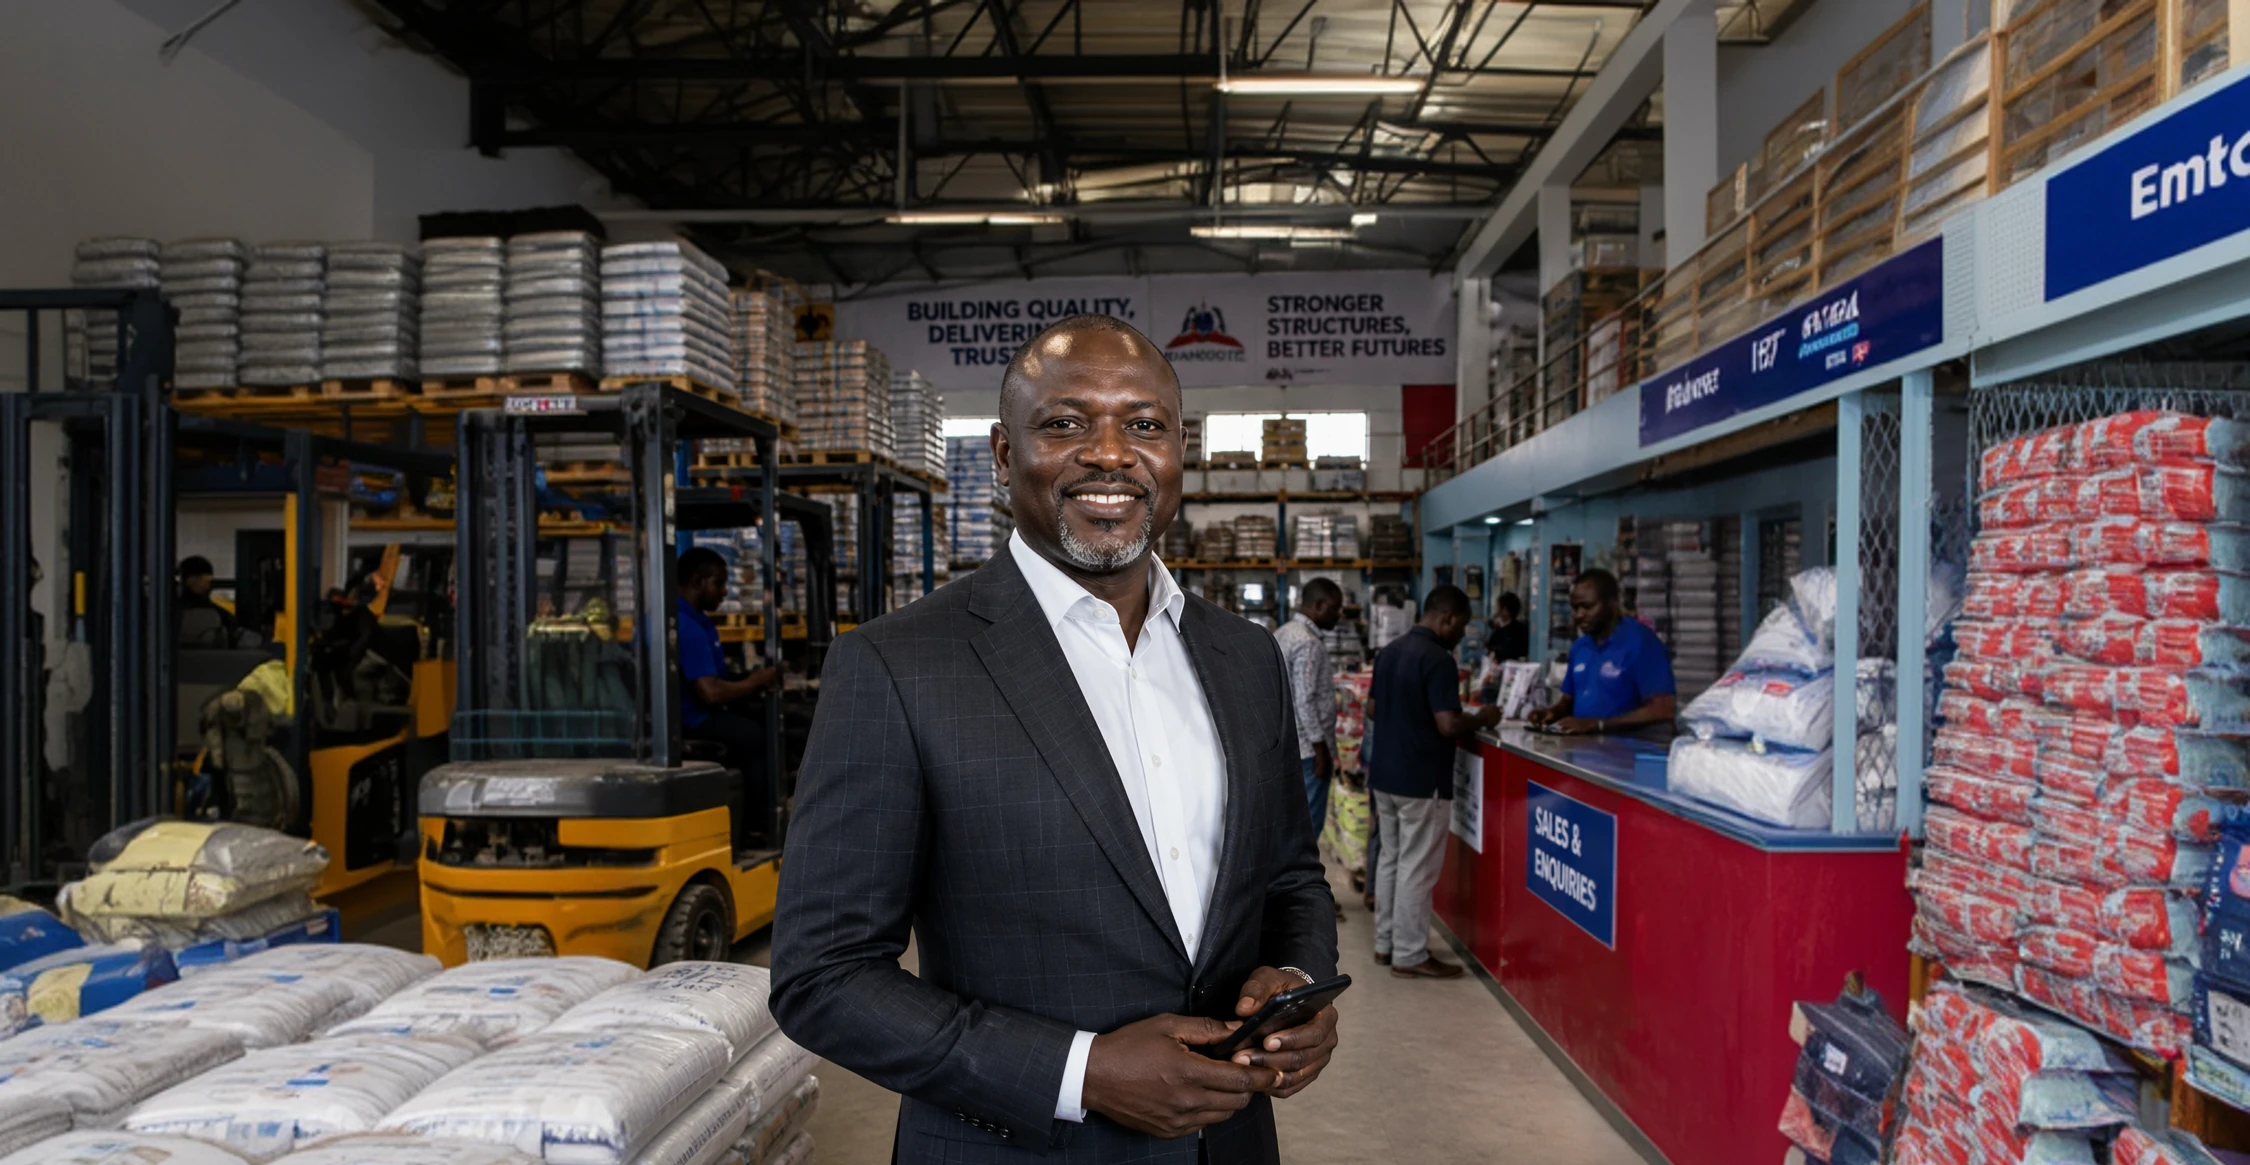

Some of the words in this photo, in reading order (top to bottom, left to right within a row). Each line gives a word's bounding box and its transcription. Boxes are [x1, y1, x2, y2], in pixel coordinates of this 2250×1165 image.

[908, 300, 1020, 321] BUILDING
[1028, 298, 1135, 319] QUALITY,
[1267, 294, 1384, 313] STRONGER
[1267, 317, 1411, 336] STRUCTURES,
[1267, 340, 1345, 358] BETTER
[1352, 338, 1446, 357] FUTURES
[1535, 806, 1569, 849] SALES
[1571, 823, 1582, 857] &
[1534, 848, 1596, 912] ENQUIRIES
